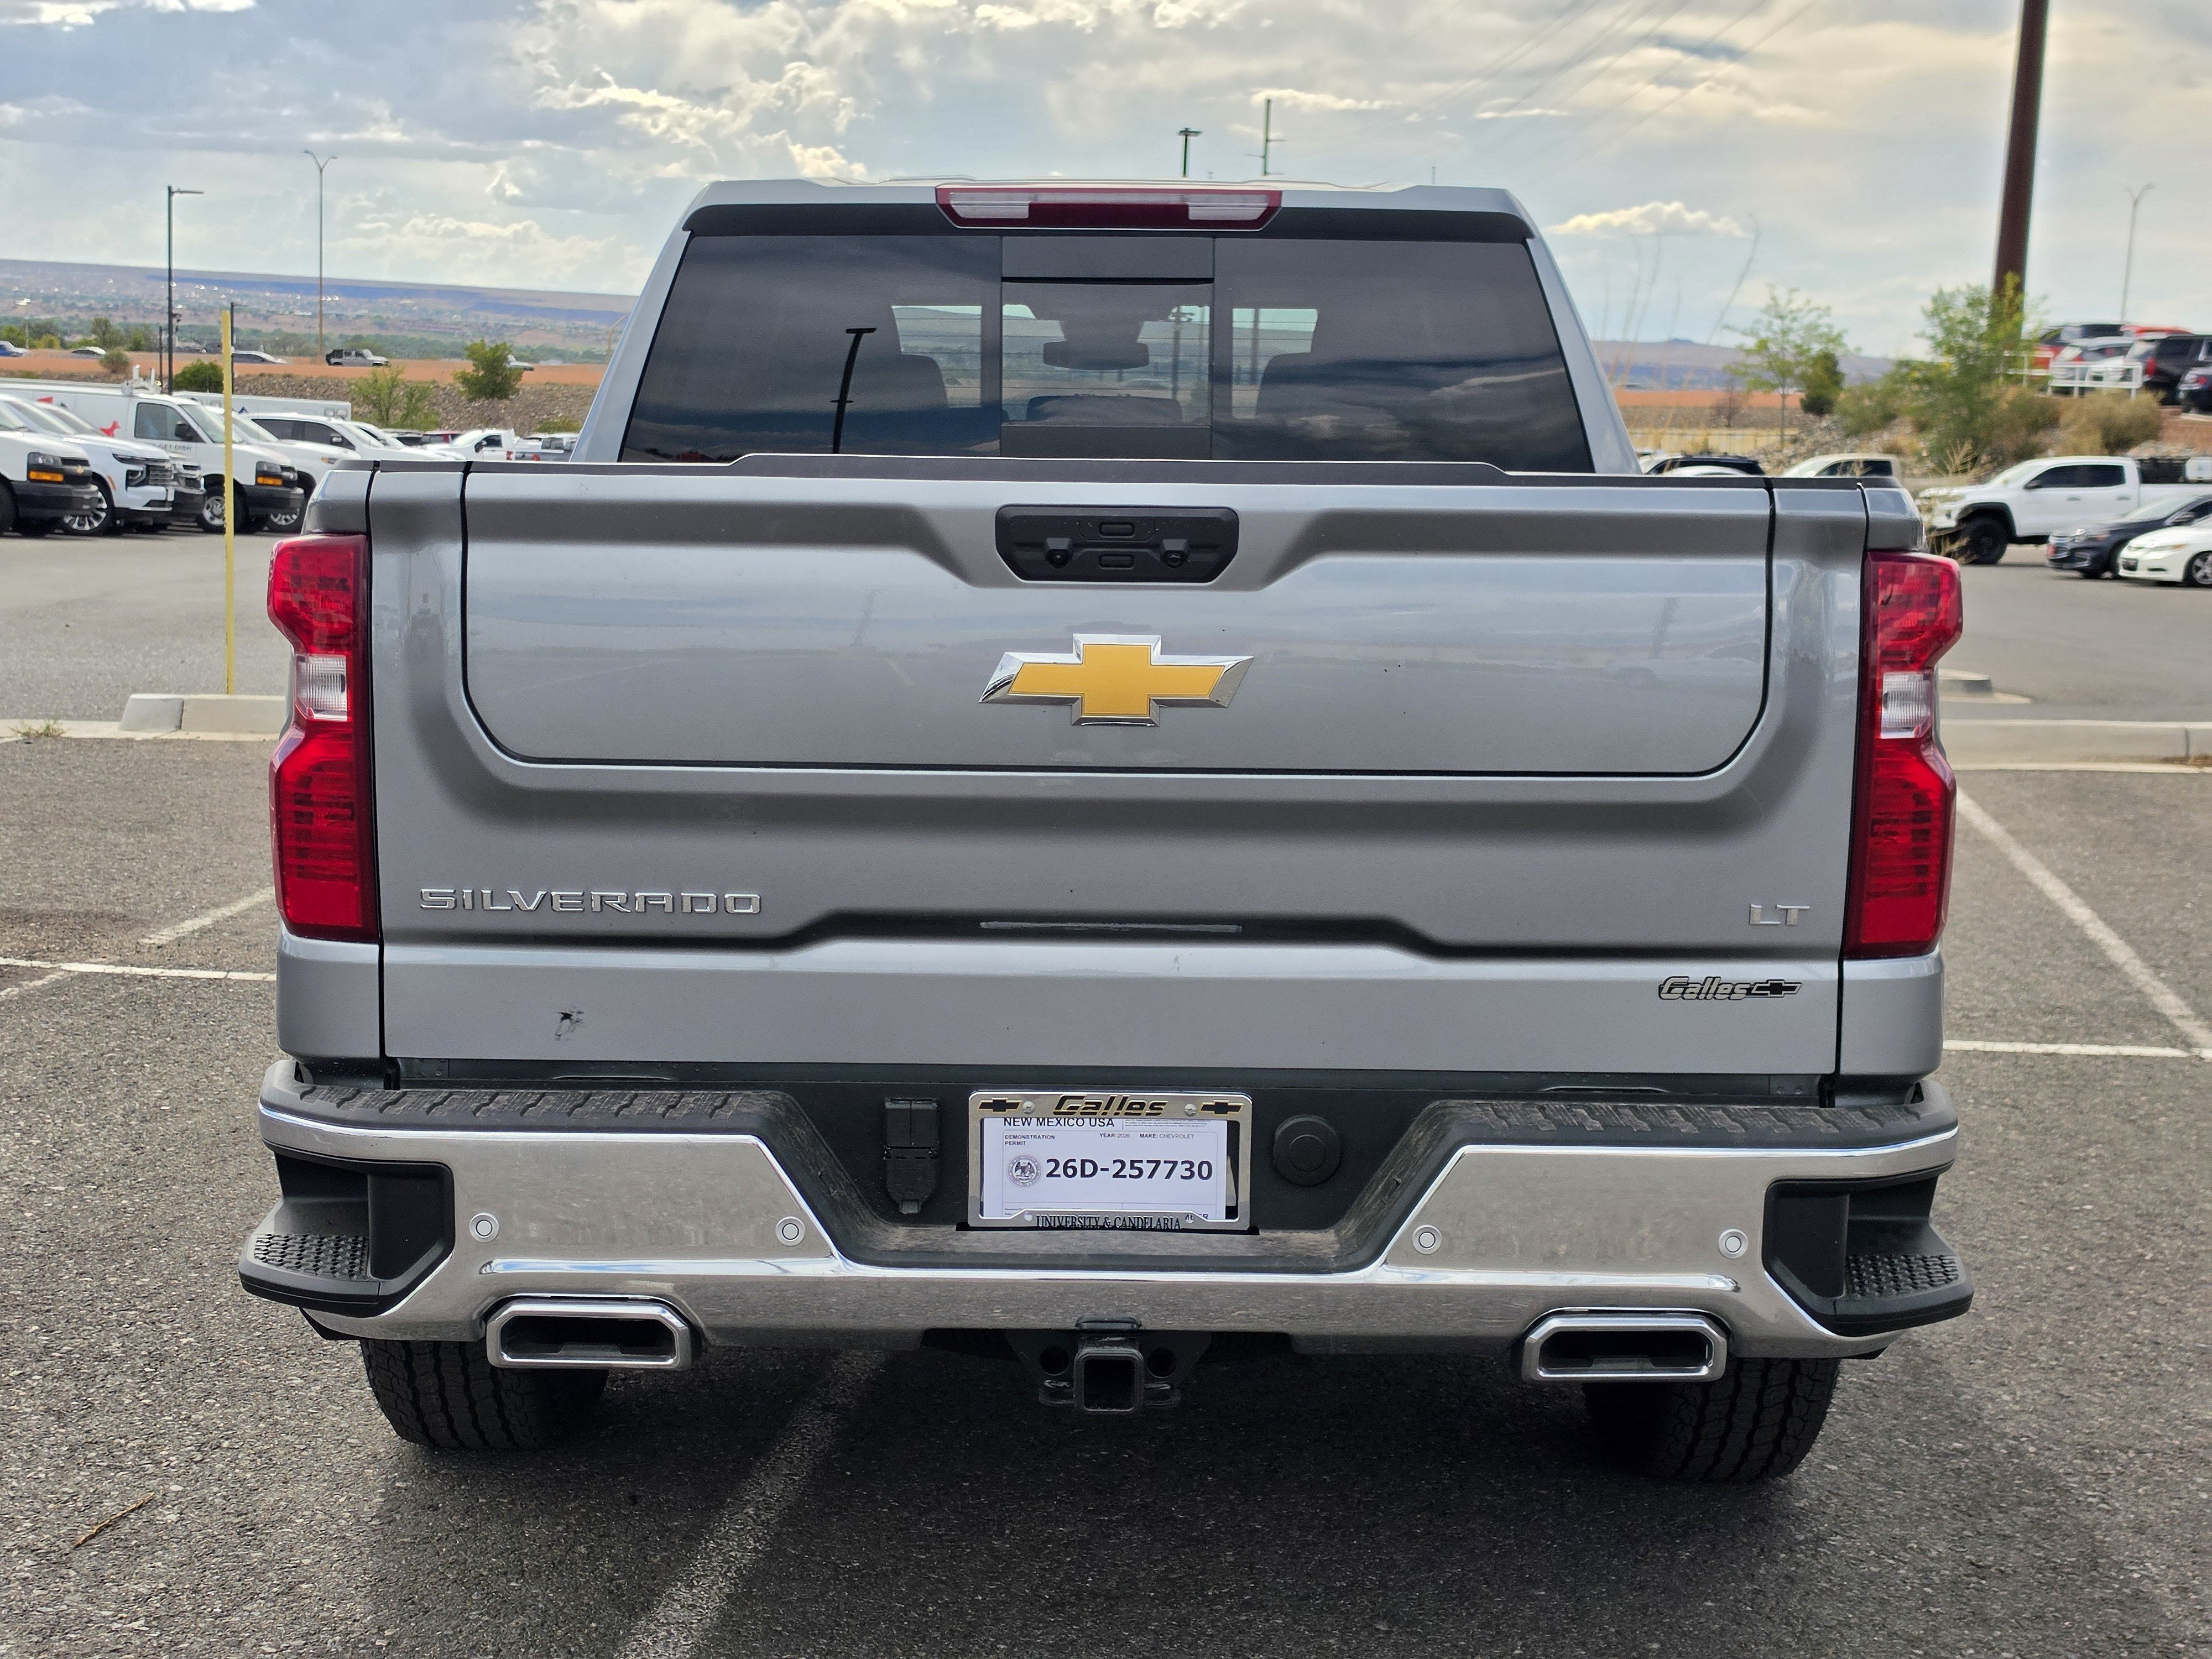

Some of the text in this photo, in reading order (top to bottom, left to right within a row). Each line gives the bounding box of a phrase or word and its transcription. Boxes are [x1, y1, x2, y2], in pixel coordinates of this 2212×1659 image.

[420, 888, 762, 914] SILVERADO
[1749, 904, 1811, 925] LT
[1658, 976, 1752, 1000] Galles
[1052, 1094, 1168, 1116] Galles
[1004, 1118, 1115, 1128] NEW MEXICO USA
[1046, 1159, 1213, 1181] 26D-257730
[1036, 1214, 1101, 1228] UNIVERSITY
[1104, 1215, 1112, 1228] &
[1114, 1216, 1181, 1230] CANDELARIA
